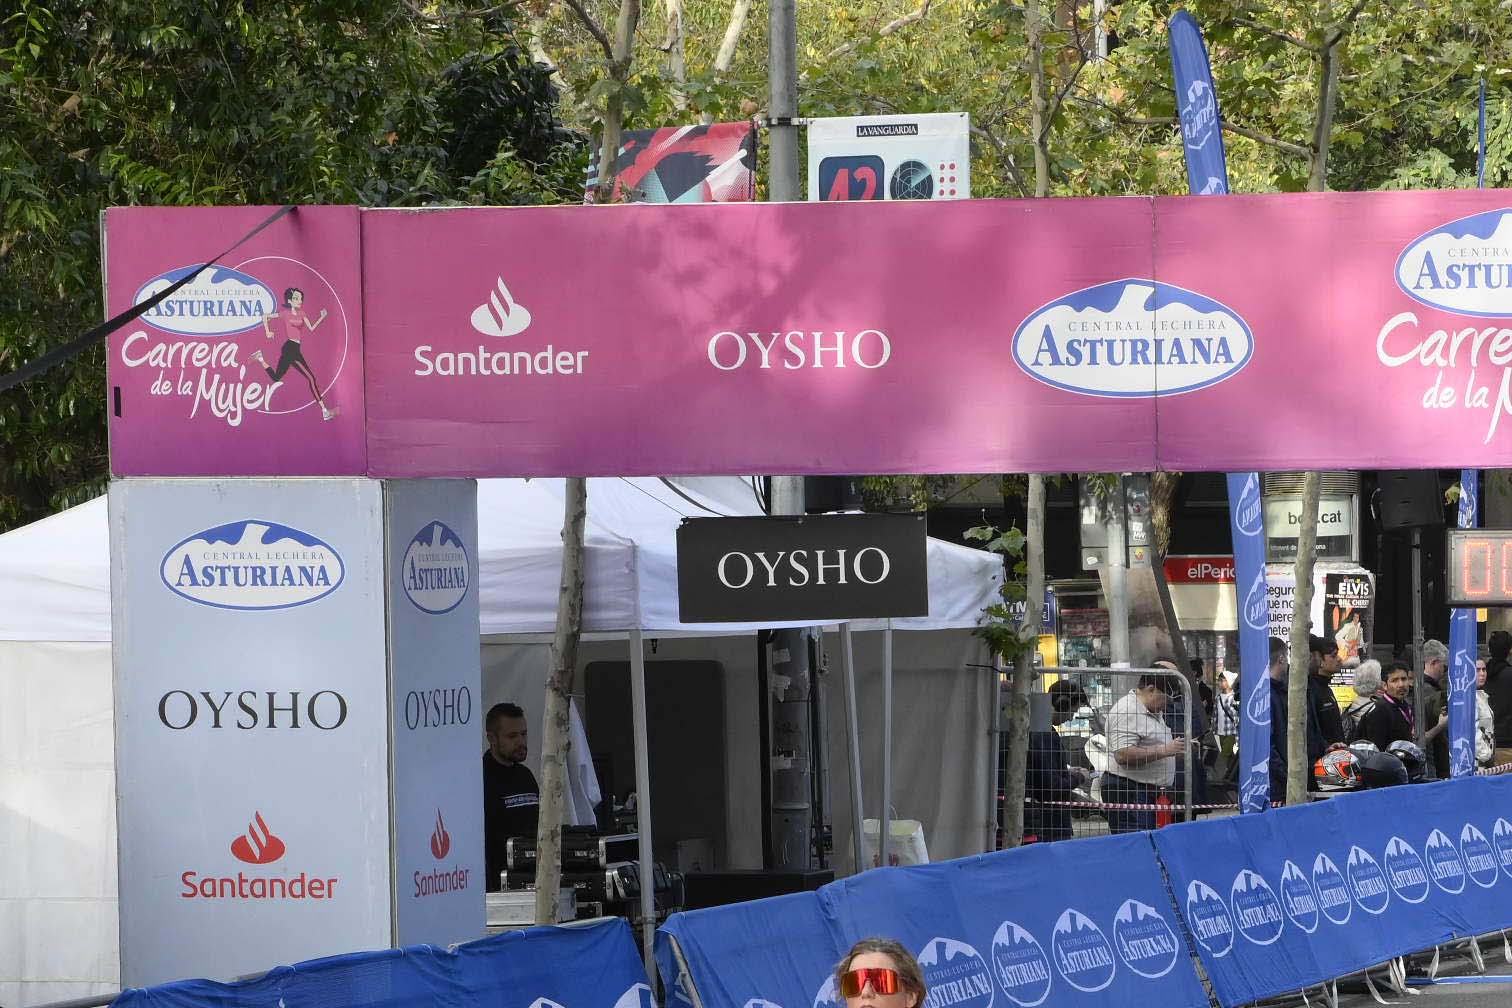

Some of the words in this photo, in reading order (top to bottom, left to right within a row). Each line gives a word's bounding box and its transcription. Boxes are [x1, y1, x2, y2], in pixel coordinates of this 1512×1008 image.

[144, 290, 265, 317] ASTURIANA
[171, 289, 210, 297] ENTRAL
[215, 288, 261, 297] LECHERA
[1068, 321, 1143, 332] CENTRAL
[1151, 320, 1226, 331] LECHERA
[121, 331, 239, 369] Carrera
[414, 345, 589, 377] Santander
[707, 329, 891, 371] OYSHO
[1031, 324, 1234, 366] ASTURIANA
[150, 371, 173, 396] de
[178, 371, 193, 396] la
[190, 365, 284, 427] Mujer
[1422, 371, 1457, 408] de
[1464, 368, 1489, 408] la
[175, 554, 332, 588] ASTURIANA
[203, 551, 261, 560] CENTRAL
[267, 551, 325, 560] LECHERA
[718, 547, 890, 589] OYSHO
[407, 555, 466, 591] ASTURIANA
[1339, 583, 1369, 595] ELVIS
[158, 690, 347, 730] OYSHO
[405, 685, 472, 730] OYSHO
[181, 871, 338, 899] Santander
[413, 864, 469, 898] Santander
[997, 956, 1048, 988] ASTURIANA
[1058, 944, 1112, 974] ASTURIANA
